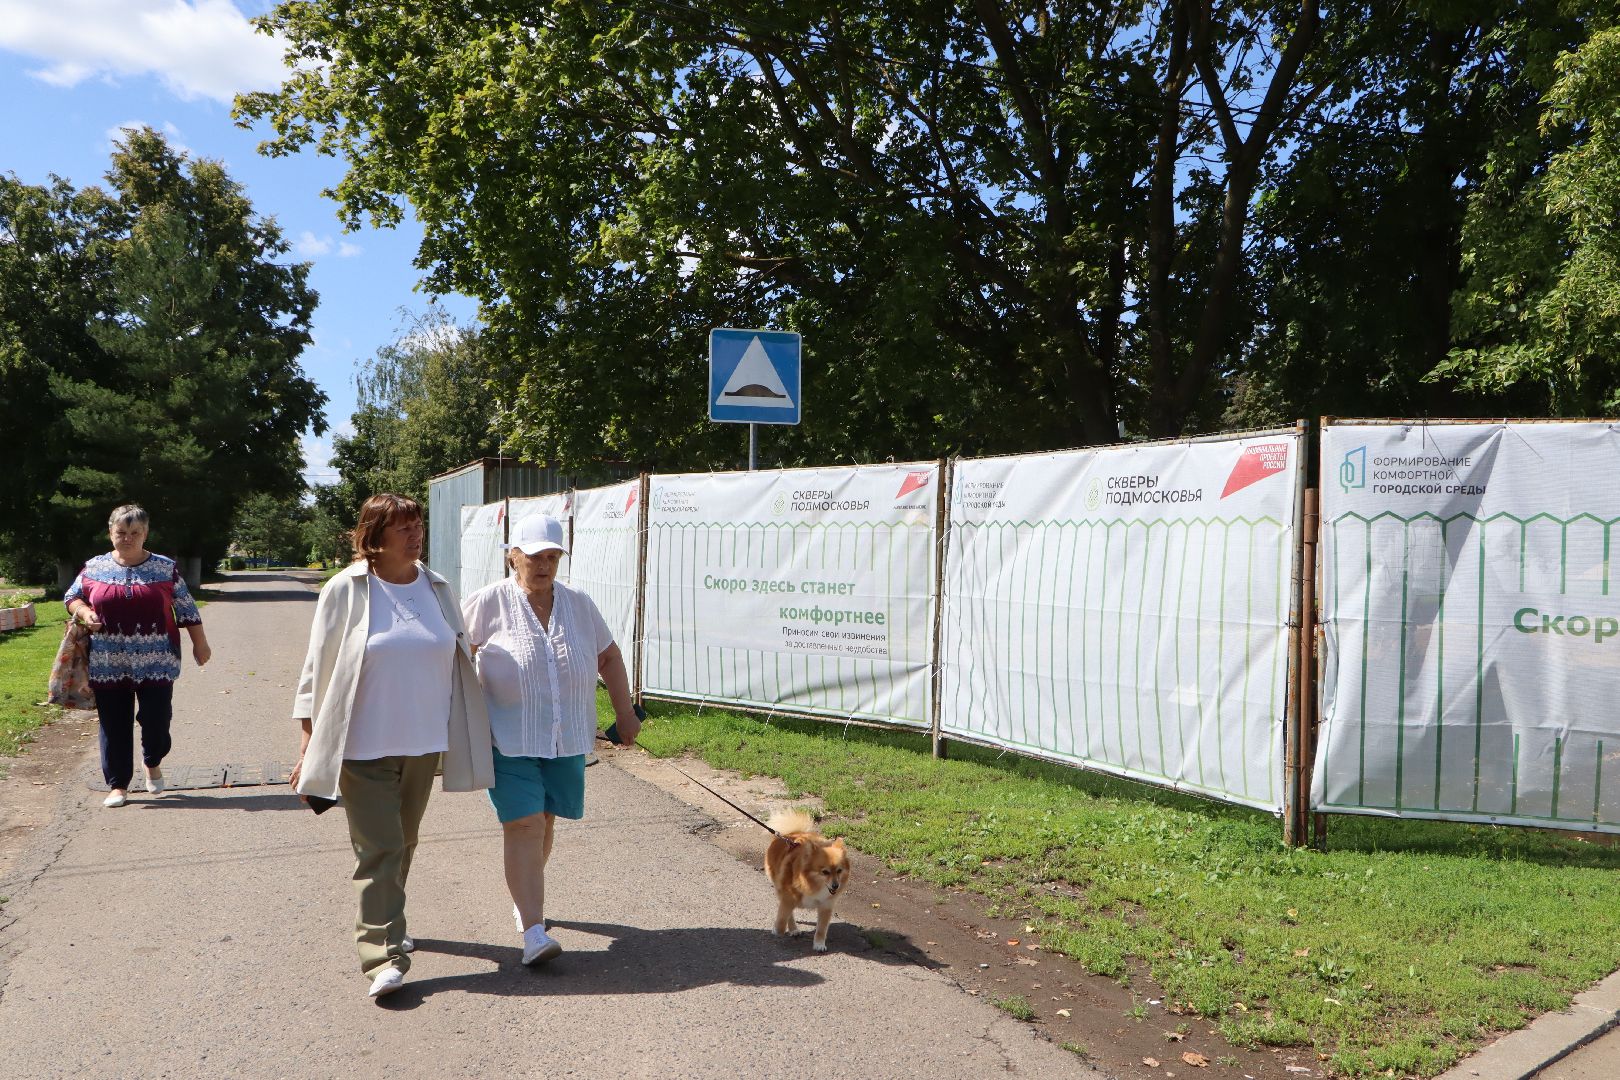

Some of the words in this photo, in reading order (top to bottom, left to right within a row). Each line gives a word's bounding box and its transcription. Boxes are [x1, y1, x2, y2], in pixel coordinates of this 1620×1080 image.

[1373, 456, 1472, 467] ФОРМИРОВАНИЕ
[1373, 468, 1454, 480] КОМФОРТНОЙ
[1107, 475, 1159, 489] СКВЕРЫ
[1373, 482, 1442, 495] ГОРОДСКОЙ
[1445, 484, 1486, 495] СРЕДЫ
[792, 490, 834, 500] СКВЕРЫ
[1105, 488, 1202, 506] ПОДМОСКОВЬЯ
[790, 500, 870, 512] ПОДМОСКОВЬЯ
[704, 574, 747, 594] Скоро
[751, 578, 796, 595] здесь
[800, 580, 856, 596] станет
[779, 605, 885, 626] комфортнее
[782, 626, 819, 638] Приносим
[821, 631, 840, 639] свои
[842, 633, 886, 642] извинения
[845, 645, 888, 655] неудобства
